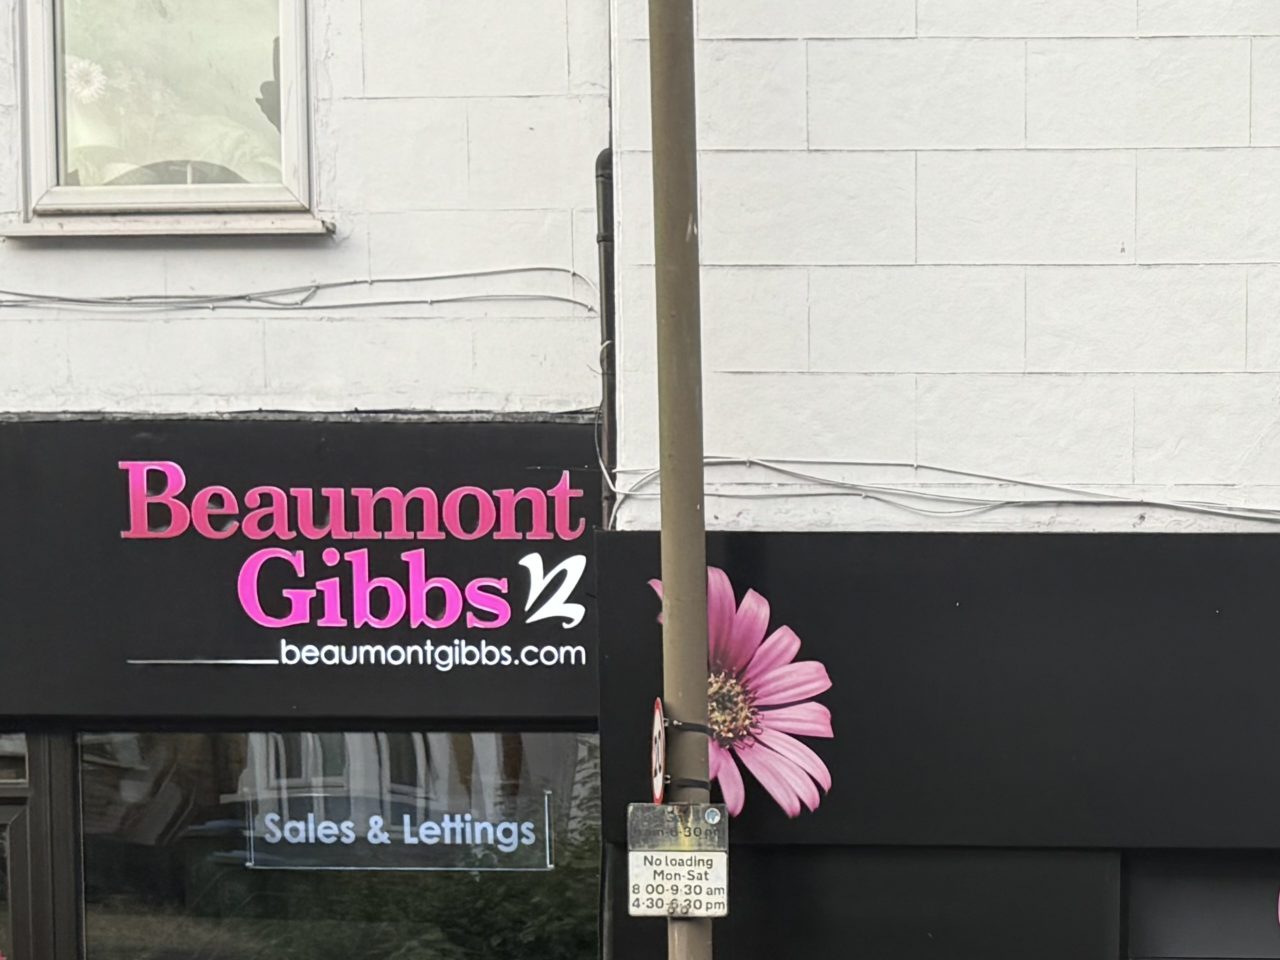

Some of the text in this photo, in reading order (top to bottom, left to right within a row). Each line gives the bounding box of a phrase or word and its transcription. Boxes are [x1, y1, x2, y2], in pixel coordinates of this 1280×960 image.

[118, 460, 586, 540] Beaumont
[237, 547, 512, 629] Gibbs
[281, 639, 586, 672] beaumontgibbs.com
[264, 813, 536, 853] Sales & Lettings
[643, 855, 714, 869] No loading
[653, 870, 710, 881] Mon-Sat
[705, 900, 725, 912] pm
